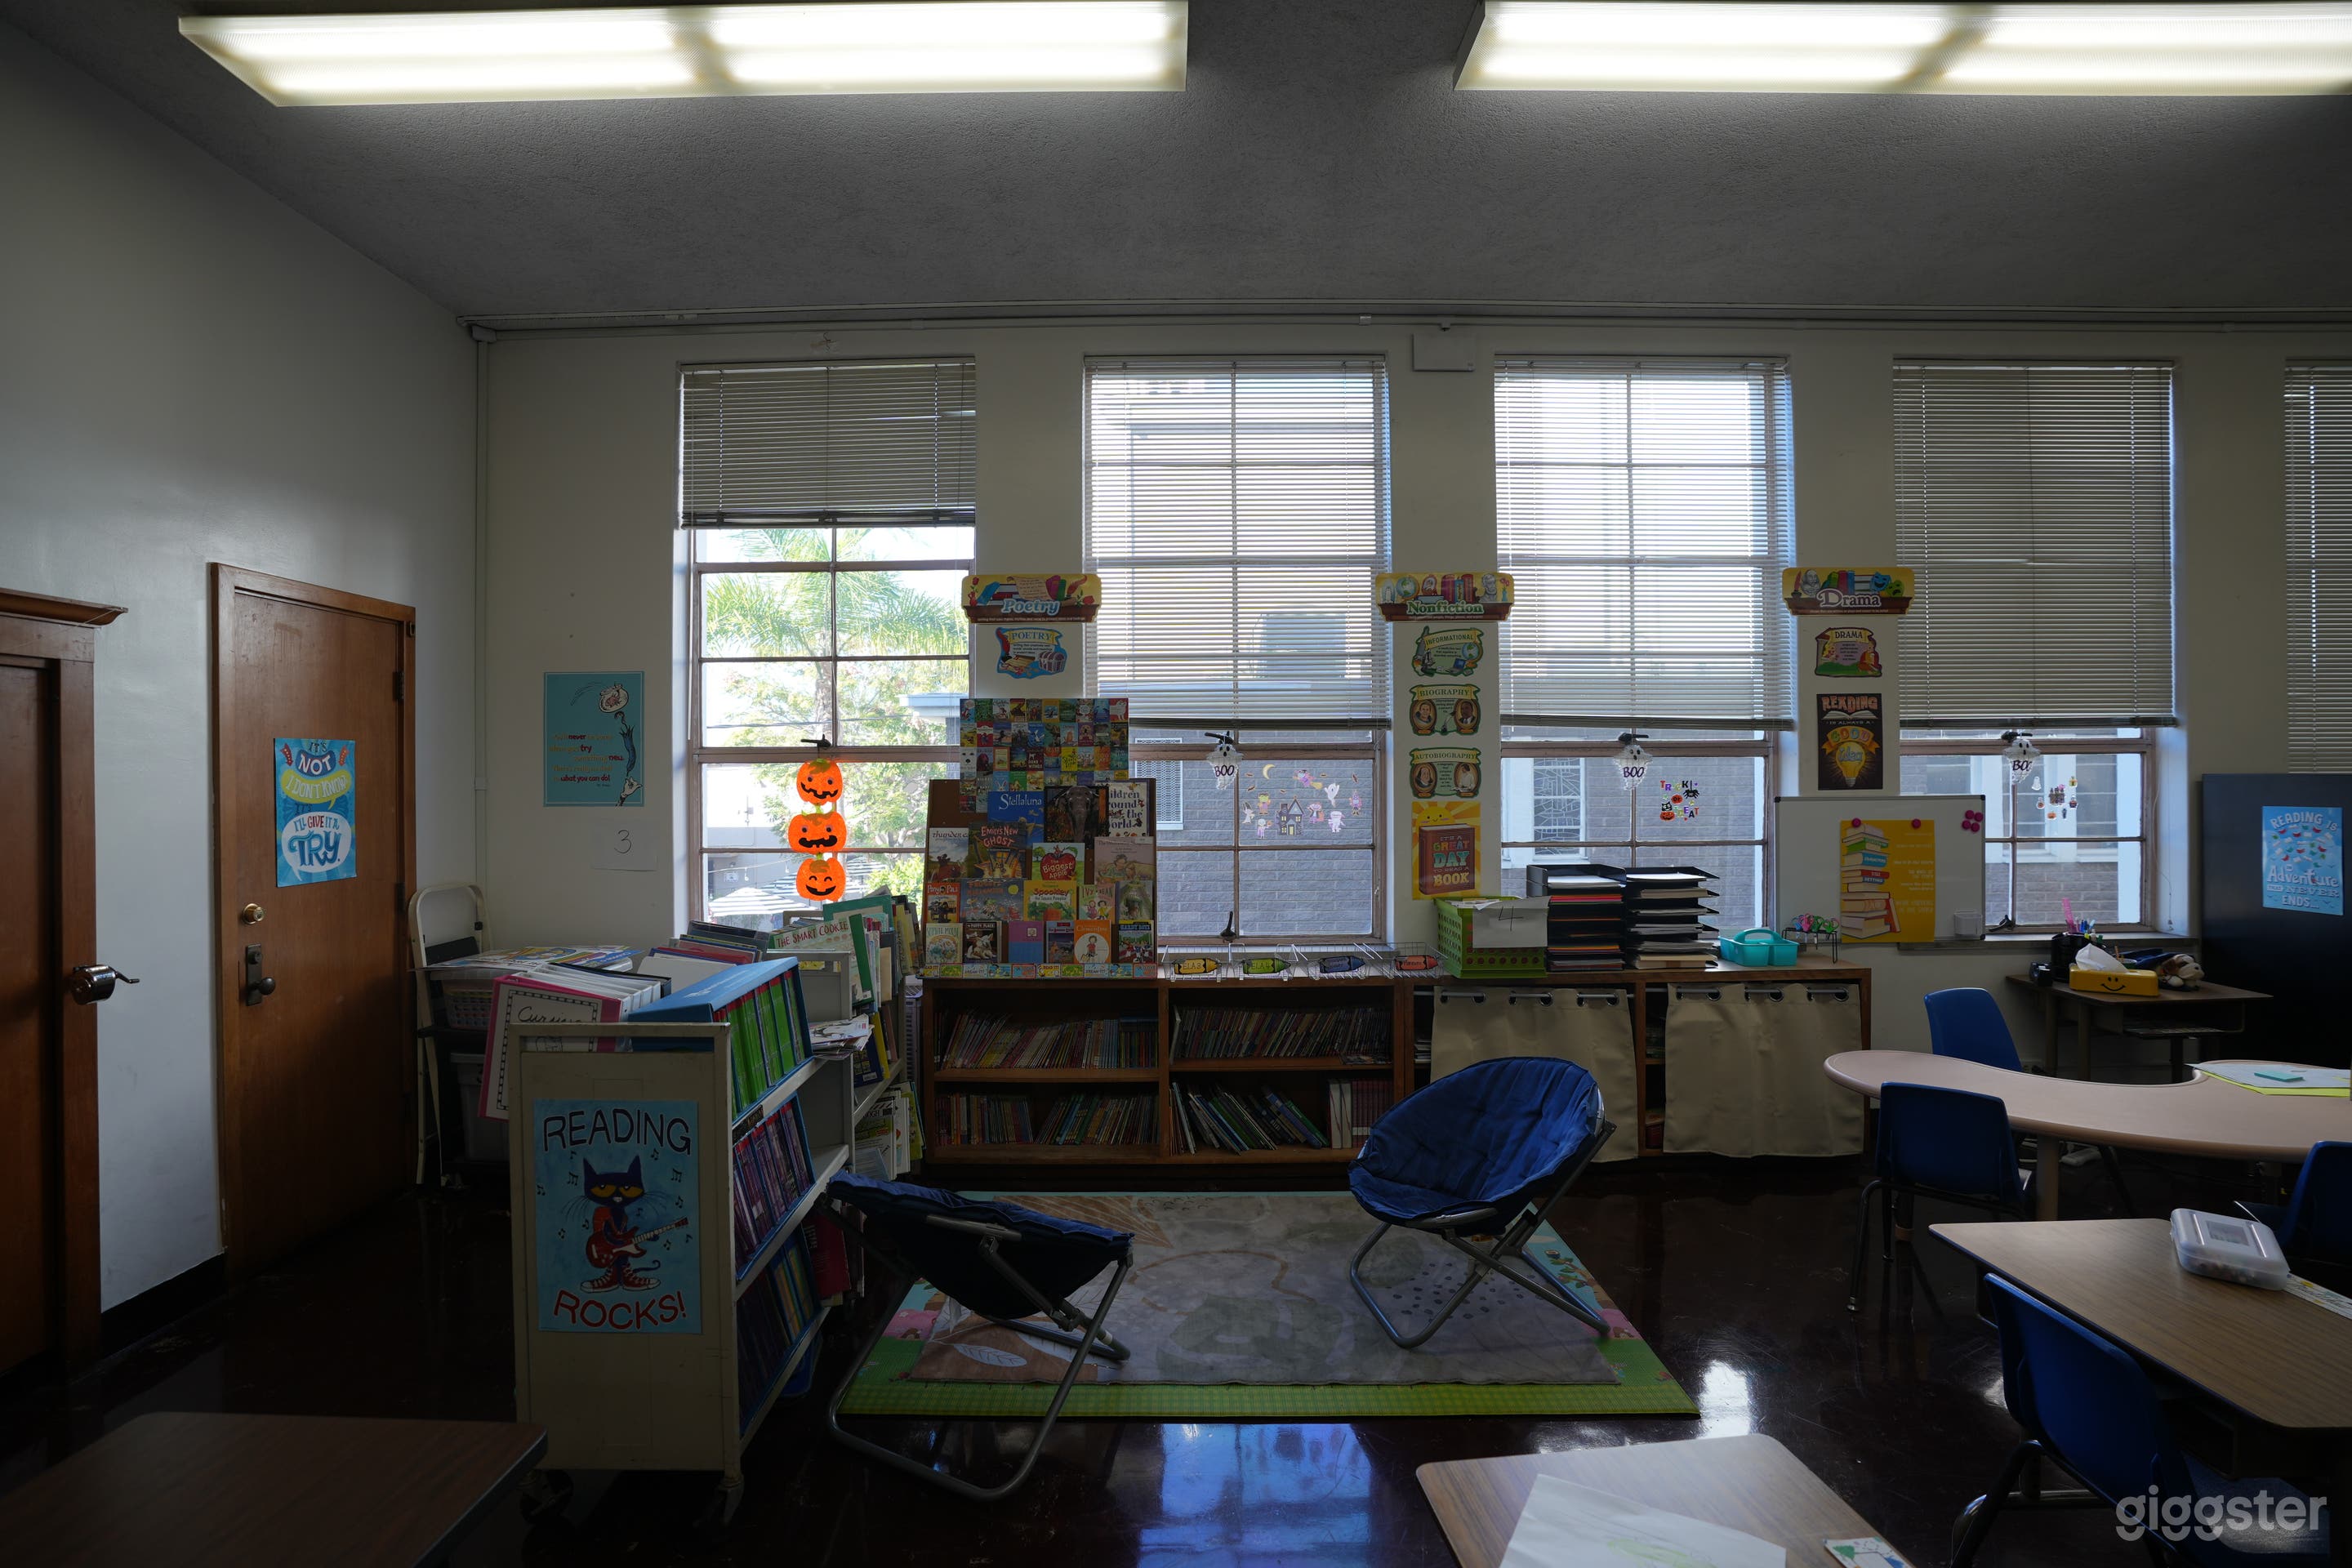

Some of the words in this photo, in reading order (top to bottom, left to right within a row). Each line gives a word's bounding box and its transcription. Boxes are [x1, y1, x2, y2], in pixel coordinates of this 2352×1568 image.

[1817, 588, 1881, 608] Drama
[1002, 599, 1060, 616] Poetry
[1407, 601, 1484, 614] Nonfiction
[1011, 631, 1054, 641] POETRY
[1425, 633, 1474, 646] INFORMATIONAL
[1834, 630, 1864, 639] DRAMA
[1821, 695, 1878, 715] READING
[1831, 728, 1871, 742] GOOD
[308, 742, 327, 753] IT'S
[580, 744, 592, 753] try
[1839, 746, 1864, 763] idea
[1414, 751, 1477, 760] AUTOBIOGRAPHY
[297, 754, 332, 775] NOT
[1214, 764, 1235, 777] BOO
[1623, 766, 1645, 777] BOO
[292, 780, 321, 799] DON'T
[1659, 780, 1689, 791] TRICK
[1110, 788, 1140, 800] ildren
[998, 793, 1043, 811] Stellaluna
[1127, 809, 1143, 819] the
[1673, 805, 1699, 818] TREAT
[294, 817, 307, 832] I'LL
[307, 815, 324, 828] GIVE
[325, 816, 332, 828] IT
[332, 819, 340, 831] A
[1111, 818, 1132, 829] orld
[2270, 811, 2324, 830] READING
[614, 829, 632, 854] 3
[982, 835, 1016, 849] GHOST
[1433, 840, 1470, 851] GREAT
[1433, 850, 1471, 868] DAY
[1042, 862, 1073, 874] Biggest
[1049, 871, 1067, 880] Apple
[1433, 872, 1470, 888] BOOK
[2266, 865, 2340, 888] Adventure
[2286, 886, 2340, 898] NEVER
[1498, 906, 1523, 932] 4
[777, 934, 790, 948] THE
[793, 928, 816, 943] SMART
[819, 920, 849, 937] COOKIE
[542, 1107, 692, 1156] READING
[553, 1289, 688, 1330] ROCKS!
